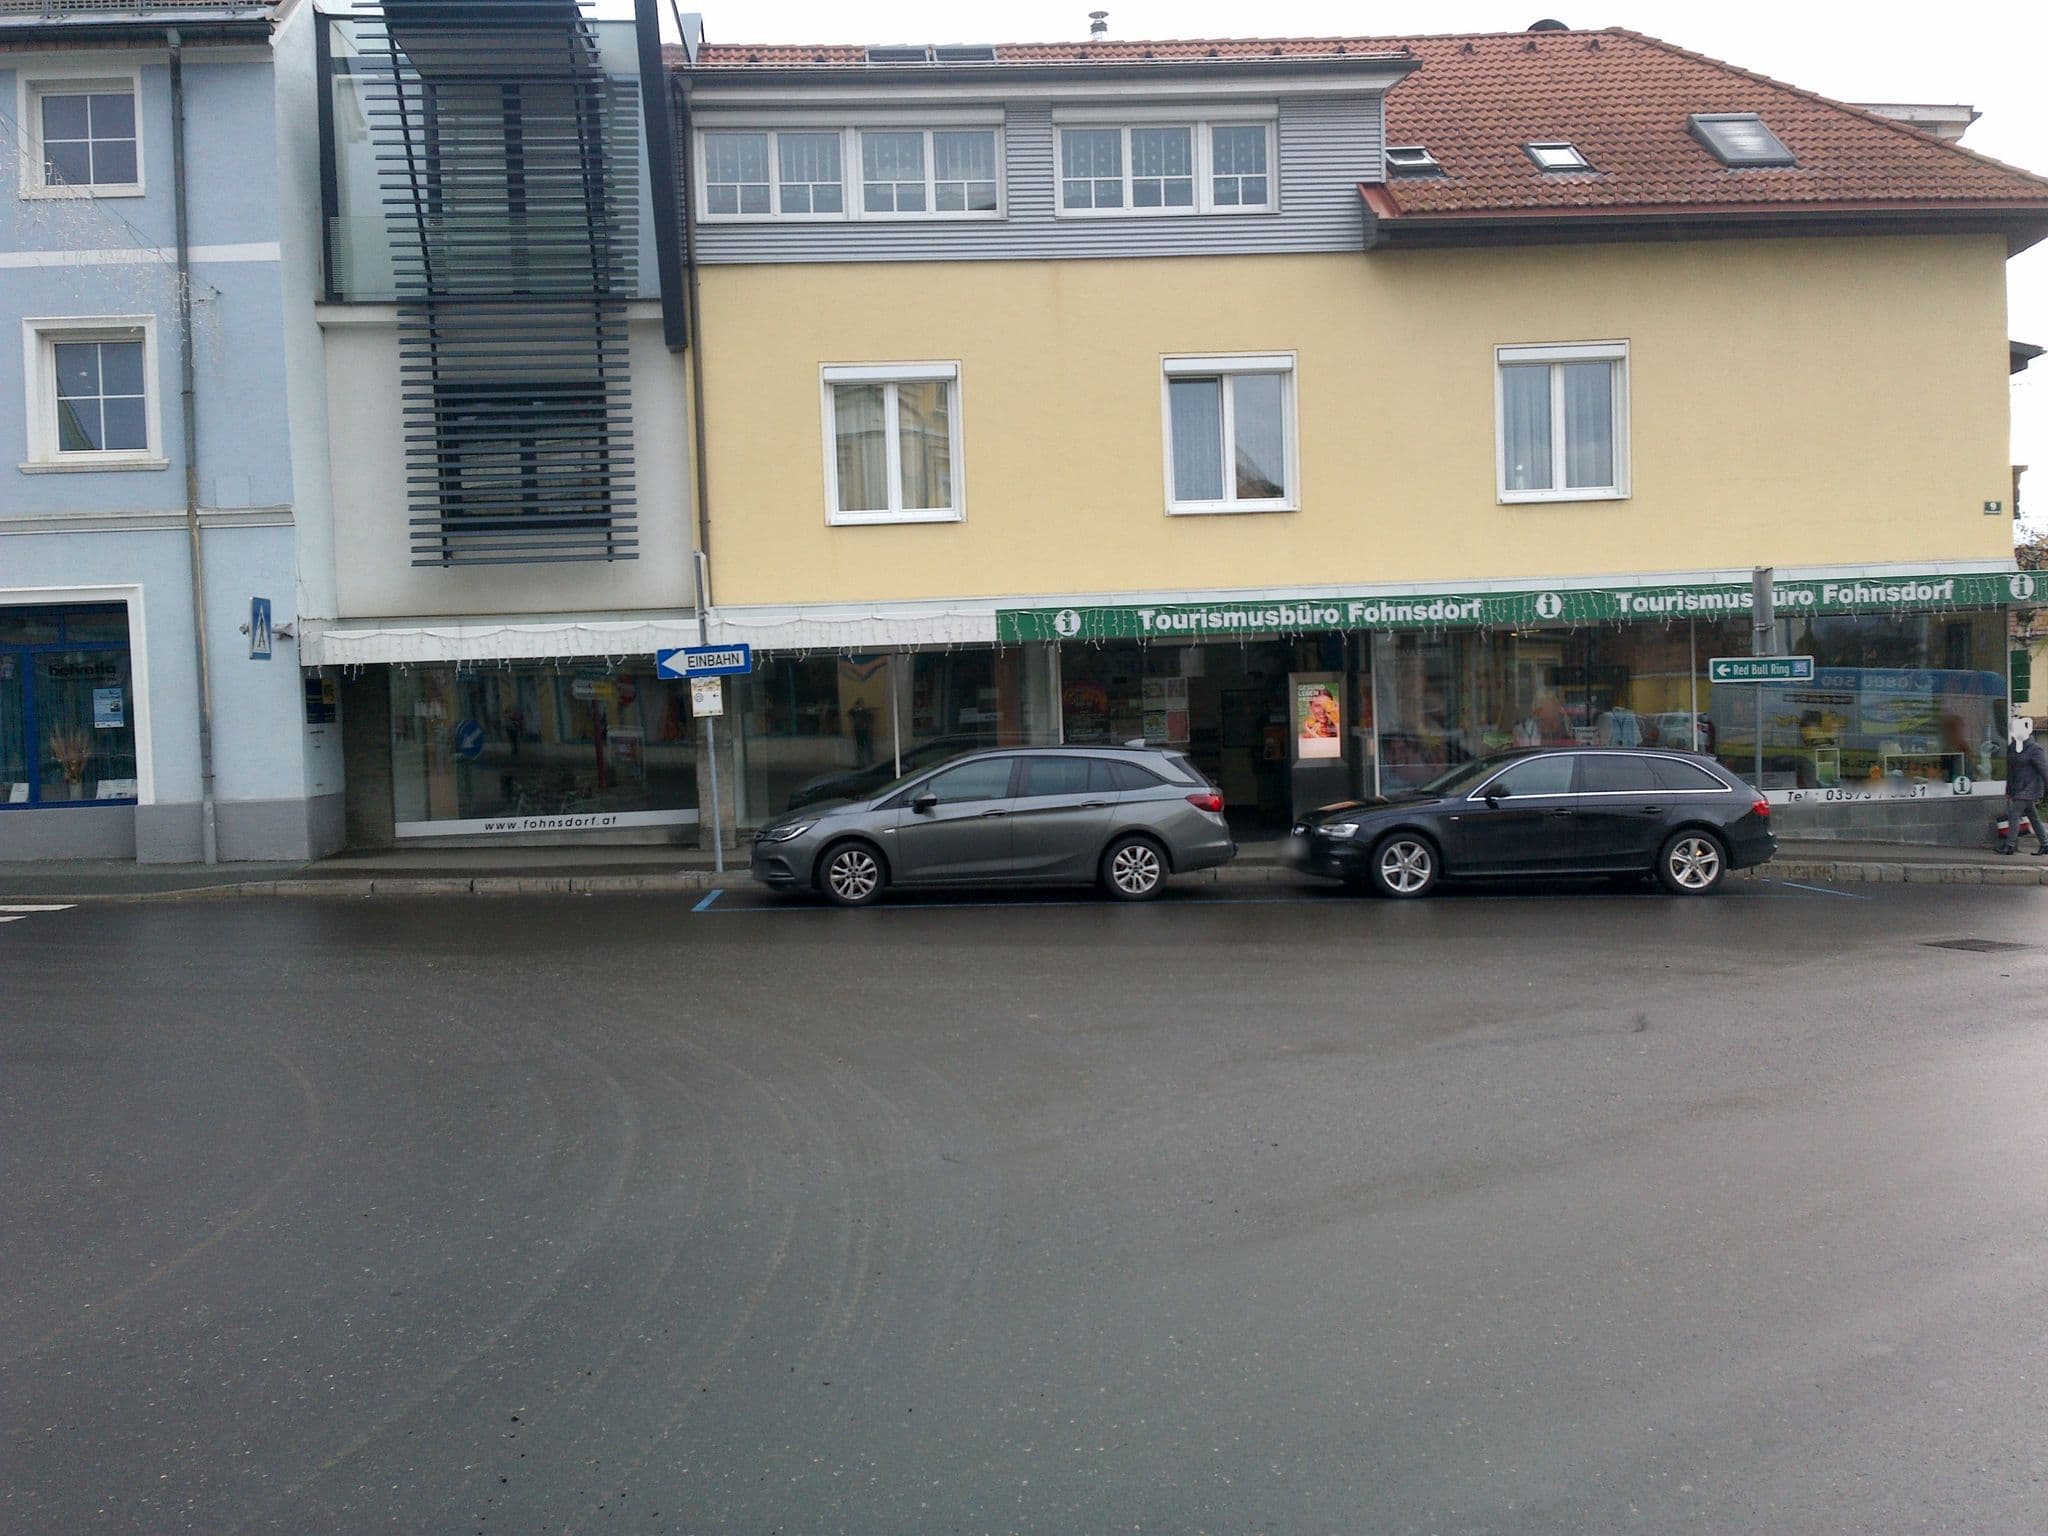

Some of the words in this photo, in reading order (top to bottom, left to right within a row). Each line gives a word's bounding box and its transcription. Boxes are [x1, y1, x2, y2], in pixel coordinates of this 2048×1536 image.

[1615, 587, 1814, 613] Tourismusüro
[1822, 580, 1954, 604] Fohnsdorf
[1137, 603, 1340, 631] Tourismusbüro
[1349, 598, 1482, 623] Fohnsdorf
[687, 652, 740, 668] EINBAHN
[1733, 664, 1749, 676] Red
[1751, 663, 1769, 675] Bull
[1770, 662, 1790, 677] Ring
[484, 816, 617, 831] www.fohnsdorf.at
